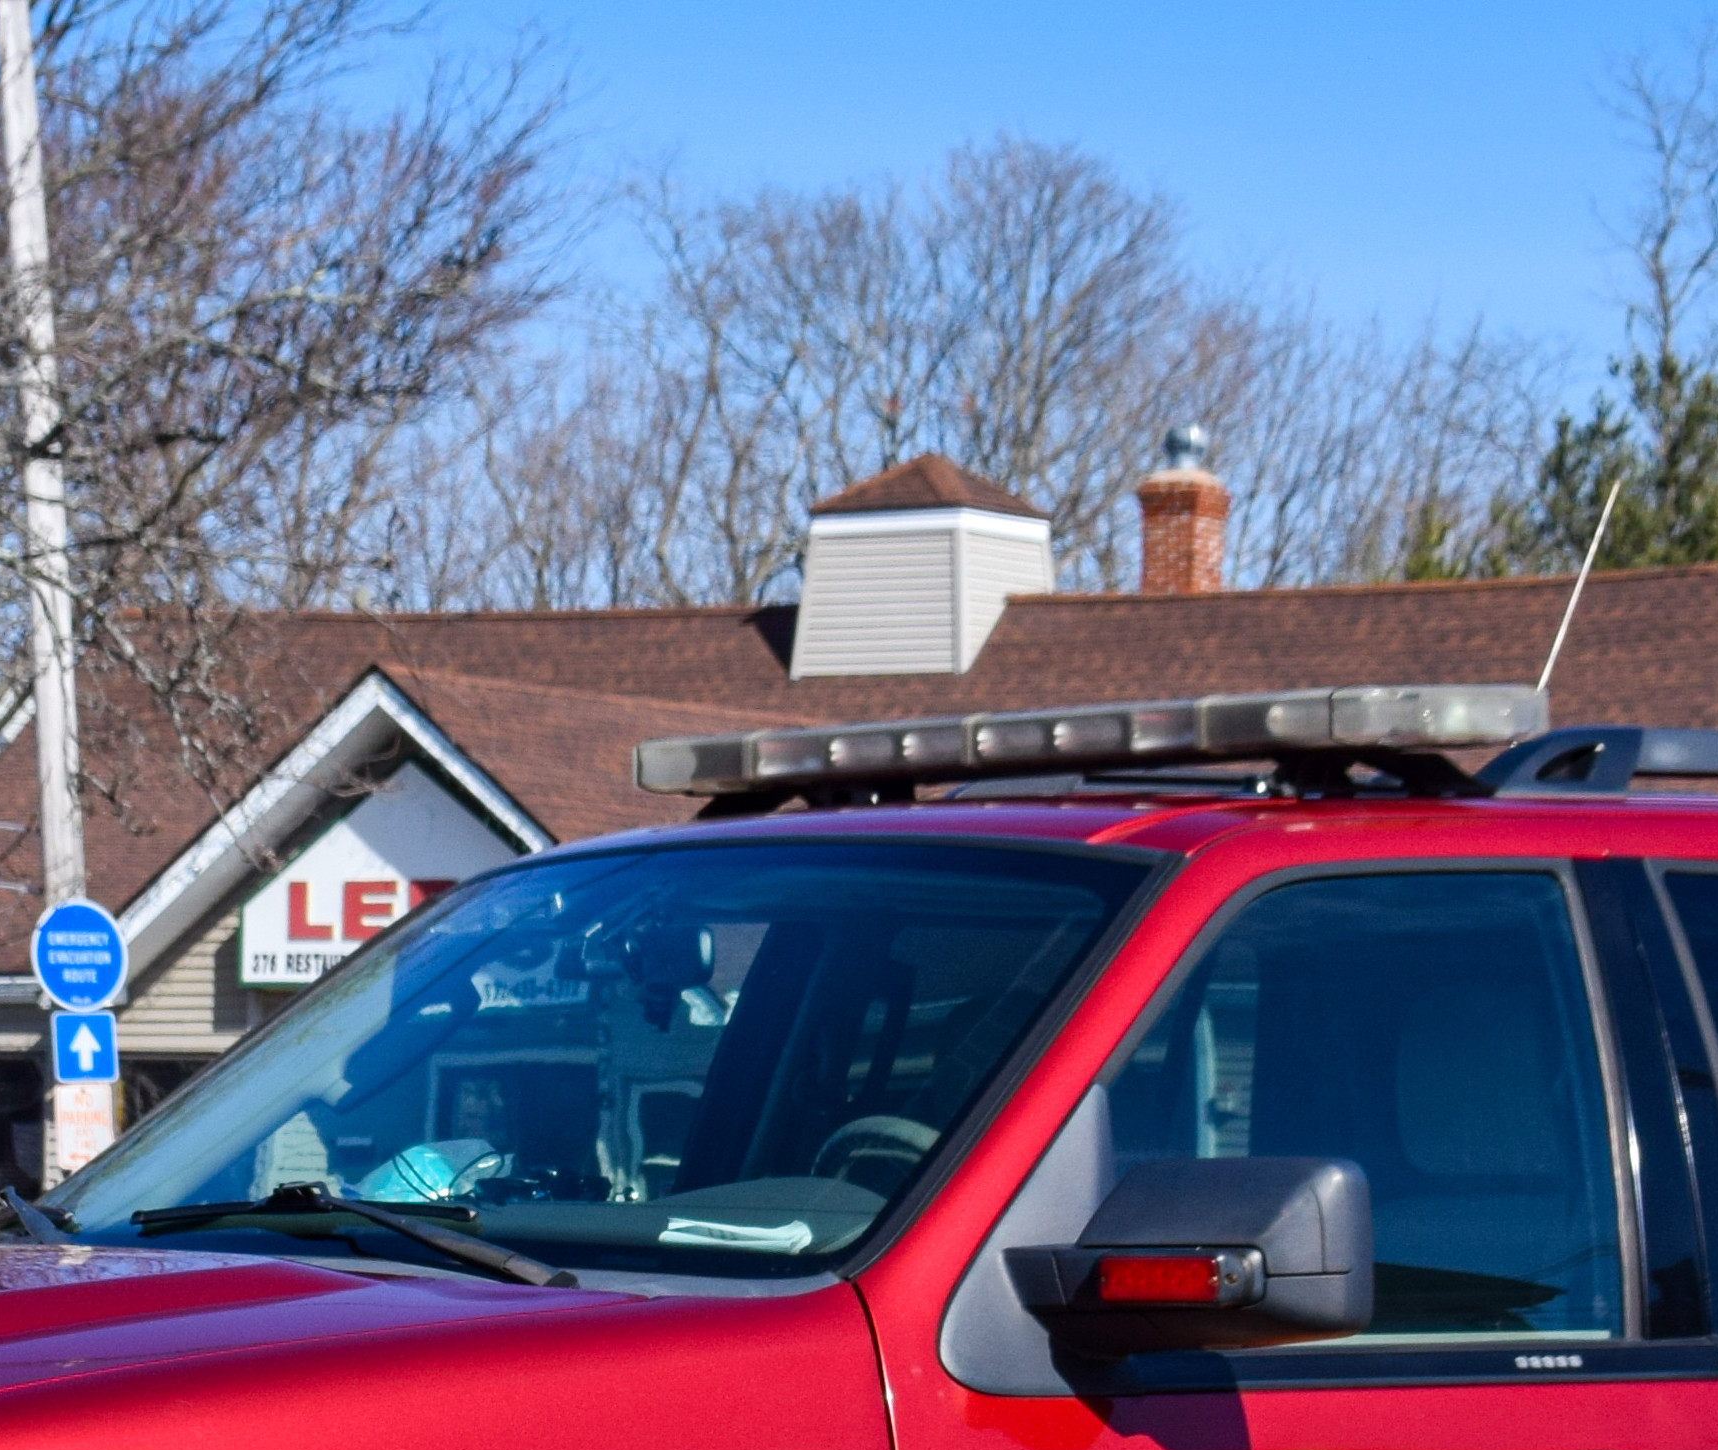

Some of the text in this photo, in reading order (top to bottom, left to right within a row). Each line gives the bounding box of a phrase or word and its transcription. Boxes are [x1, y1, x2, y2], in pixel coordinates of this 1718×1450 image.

[287, 880, 460, 941] LE
[46, 931, 110, 947] EMERGENCY
[47, 950, 112, 965] EVACUATION
[62, 968, 98, 984] ROUTE
